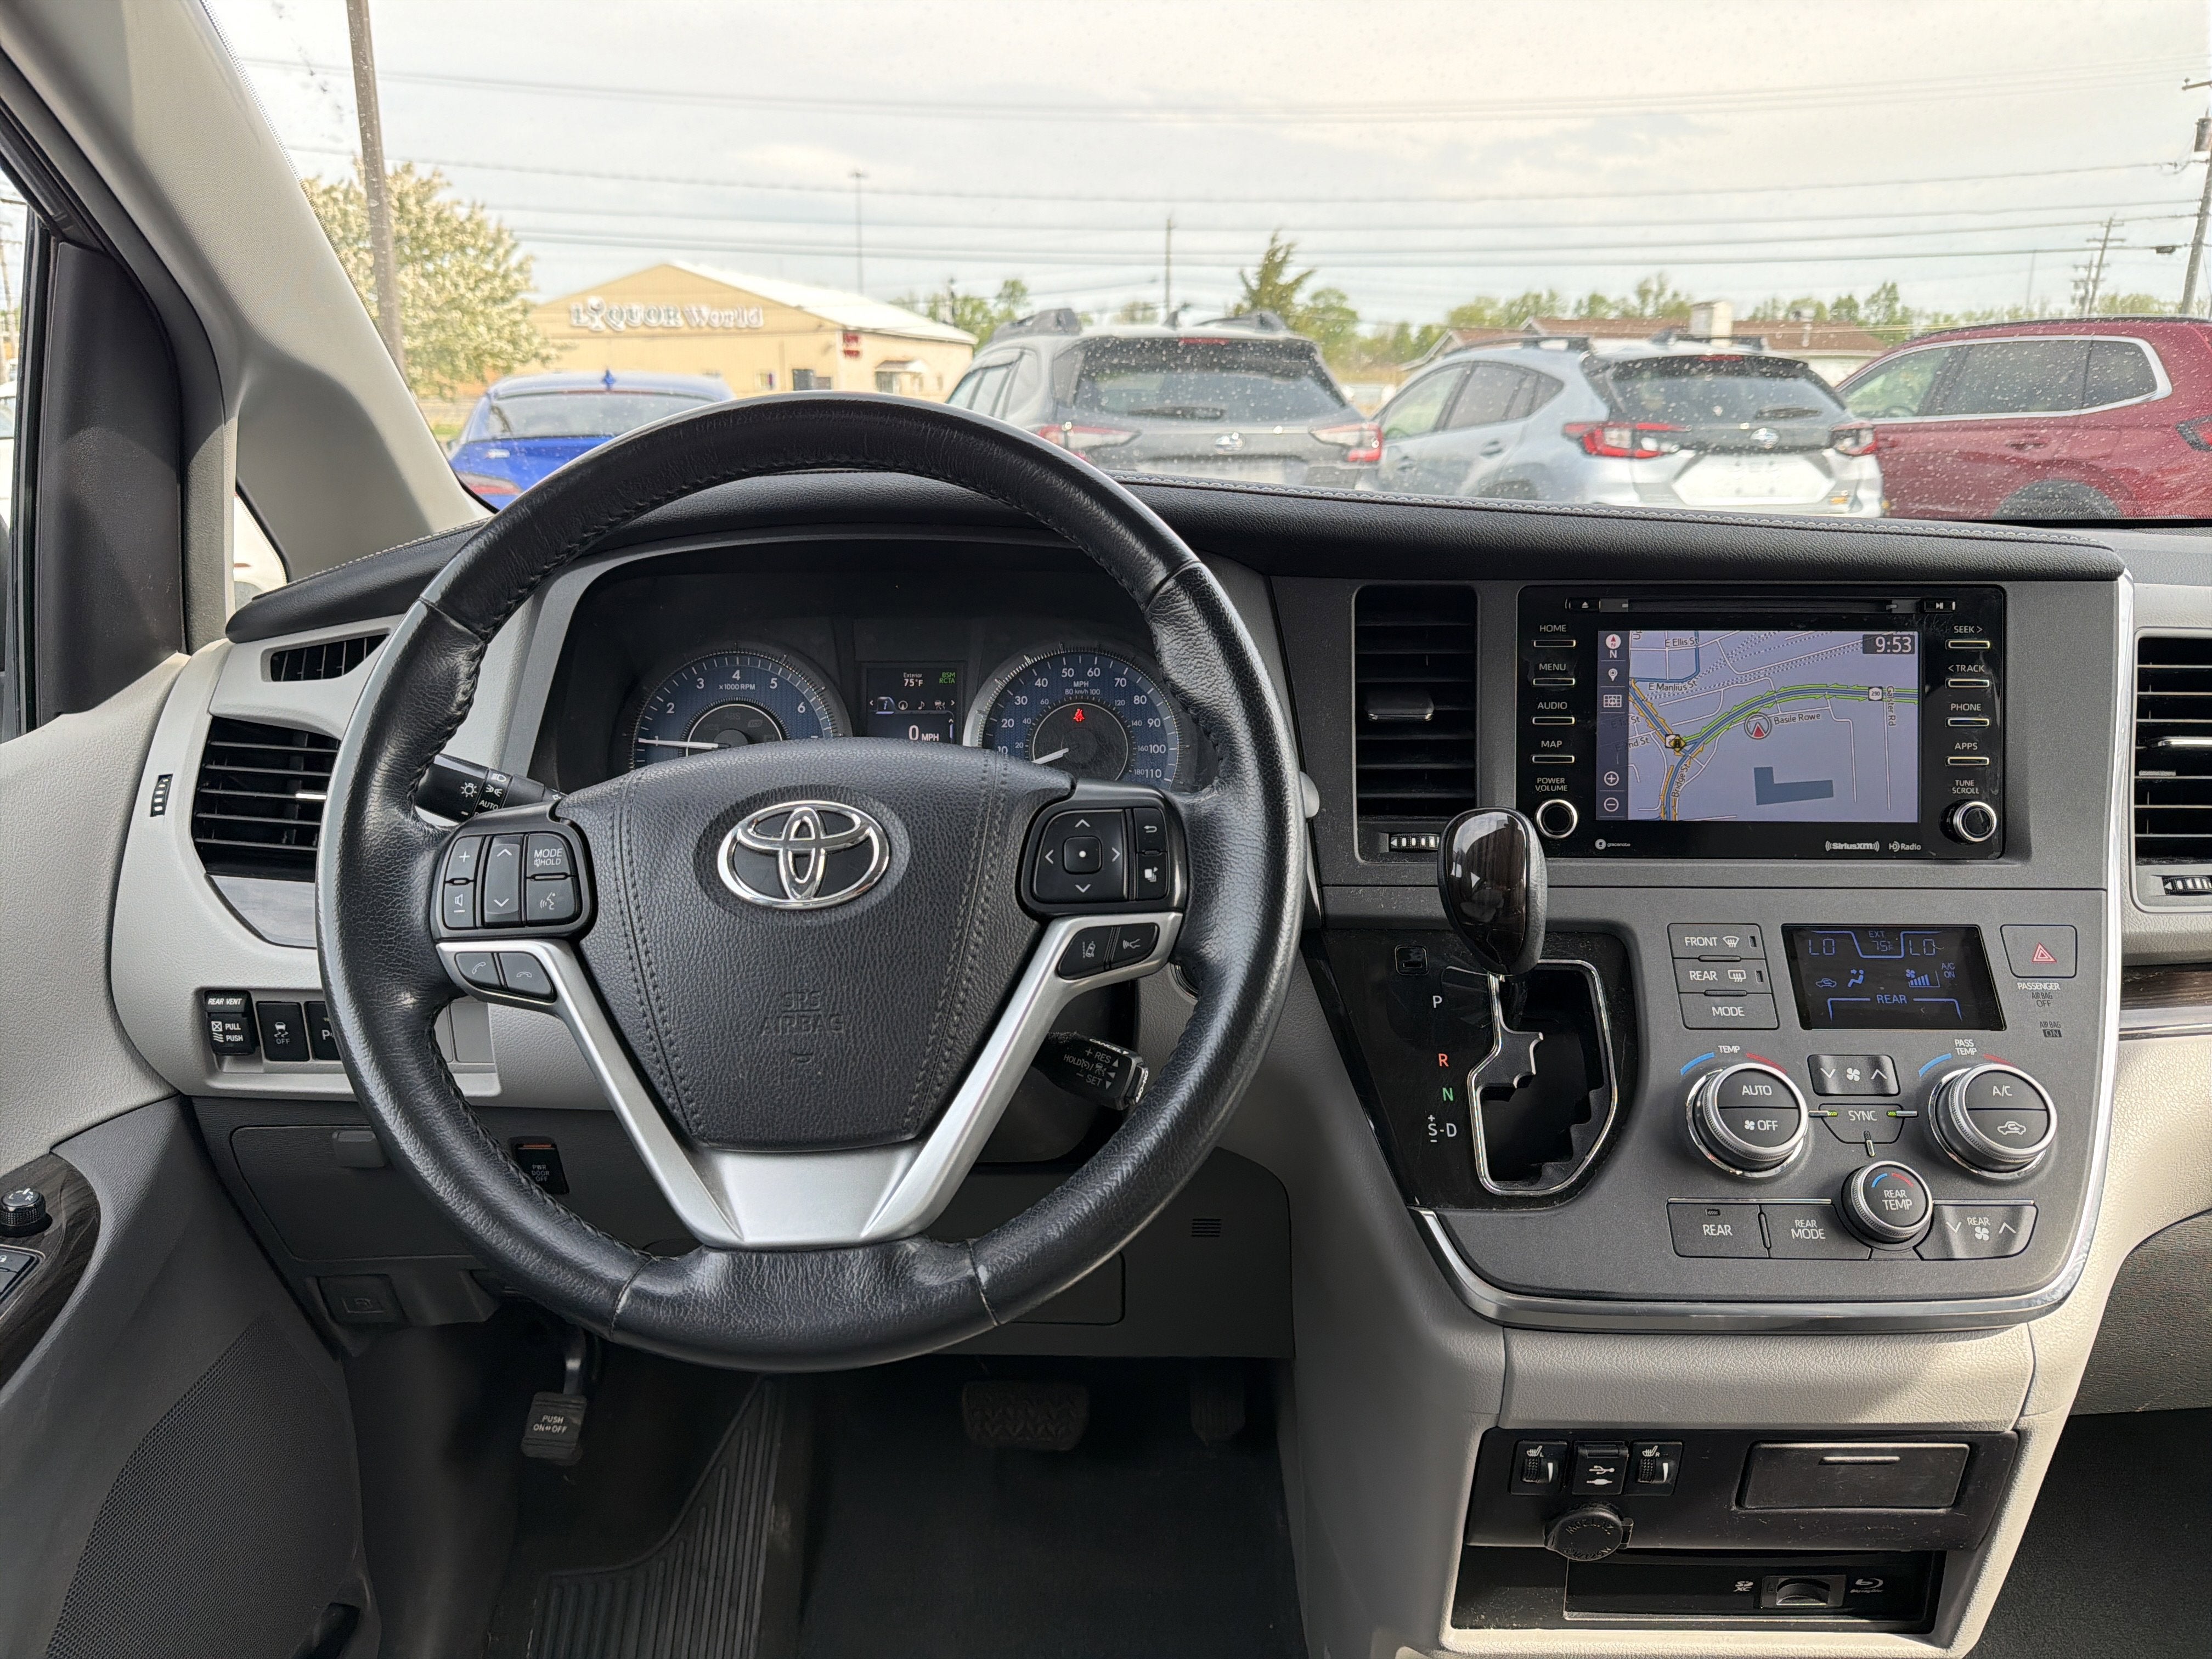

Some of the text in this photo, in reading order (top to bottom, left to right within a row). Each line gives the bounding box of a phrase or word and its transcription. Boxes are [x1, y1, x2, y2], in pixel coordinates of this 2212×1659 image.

[684, 305, 764, 328] World
[1672, 638, 1688, 646] Ellis
[1689, 637, 1699, 645] St
[1875, 637, 1912, 653] 9:53
[1610, 650, 1617, 658] N
[732, 670, 741, 680] 4
[1062, 668, 1075, 678] 50
[1087, 668, 1101, 678] 60
[696, 678, 704, 689] 3
[770, 678, 778, 689] 5
[1035, 678, 1048, 687] 40
[1114, 678, 1127, 687] 70
[1656, 682, 1687, 691] Manlius
[1688, 680, 1698, 689] St
[1014, 696, 1028, 706] 30
[1133, 695, 1147, 705] 80
[667, 703, 675, 714] 2
[798, 702, 806, 713] 6
[1001, 719, 1014, 728] 20
[1148, 718, 1161, 728] 90
[1630, 715, 1640, 724] St
[1774, 713, 1821, 724] Basile Rowe
[1888, 715, 1896, 726] Rd
[909, 725, 919, 741] 0
[1640, 737, 1650, 745] St
[998, 746, 1008, 754] 10
[1149, 744, 1166, 754] 100
[1954, 742, 1978, 751] APPS
[1145, 769, 1162, 778] 110
[1671, 763, 1691, 798] Bridge St
[478, 800, 499, 810] AUTO
[534, 848, 563, 859] MODE
[540, 858, 561, 866] HOLD
[1684, 936, 1718, 946] FRONT
[1942, 962, 1956, 970] A/C
[1689, 970, 1718, 981] REAR
[1944, 970, 1956, 979] ON
[2017, 982, 2061, 990] PASSENGER
[1432, 995, 1442, 1008] P
[1877, 995, 1908, 1005] REAR
[1712, 1006, 1745, 1017] MODE
[1089, 1038, 1122, 1053] CANCEL
[1954, 1039, 1974, 1047] PASS
[1063, 1054, 1082, 1066] HOLD
[1094, 1051, 1111, 1064] RES
[1438, 1053, 1449, 1067] R
[1086, 1075, 1103, 1087] SET
[1442, 1087, 1454, 1101] N
[1742, 1085, 1772, 1096] AUTO
[1993, 1086, 2013, 1096] A/C
[1848, 1110, 1877, 1121] SYNC
[1757, 1120, 1778, 1131] OFF
[1883, 1189, 1907, 1198] REAR
[1882, 1199, 1912, 1211] TEMP
[1795, 1219, 1817, 1228] REAR
[1967, 1217, 1990, 1226] REAR
[1702, 1224, 1733, 1236] REAR
[1791, 1228, 1826, 1239] MODE
[541, 1415, 564, 1424] PUSH
